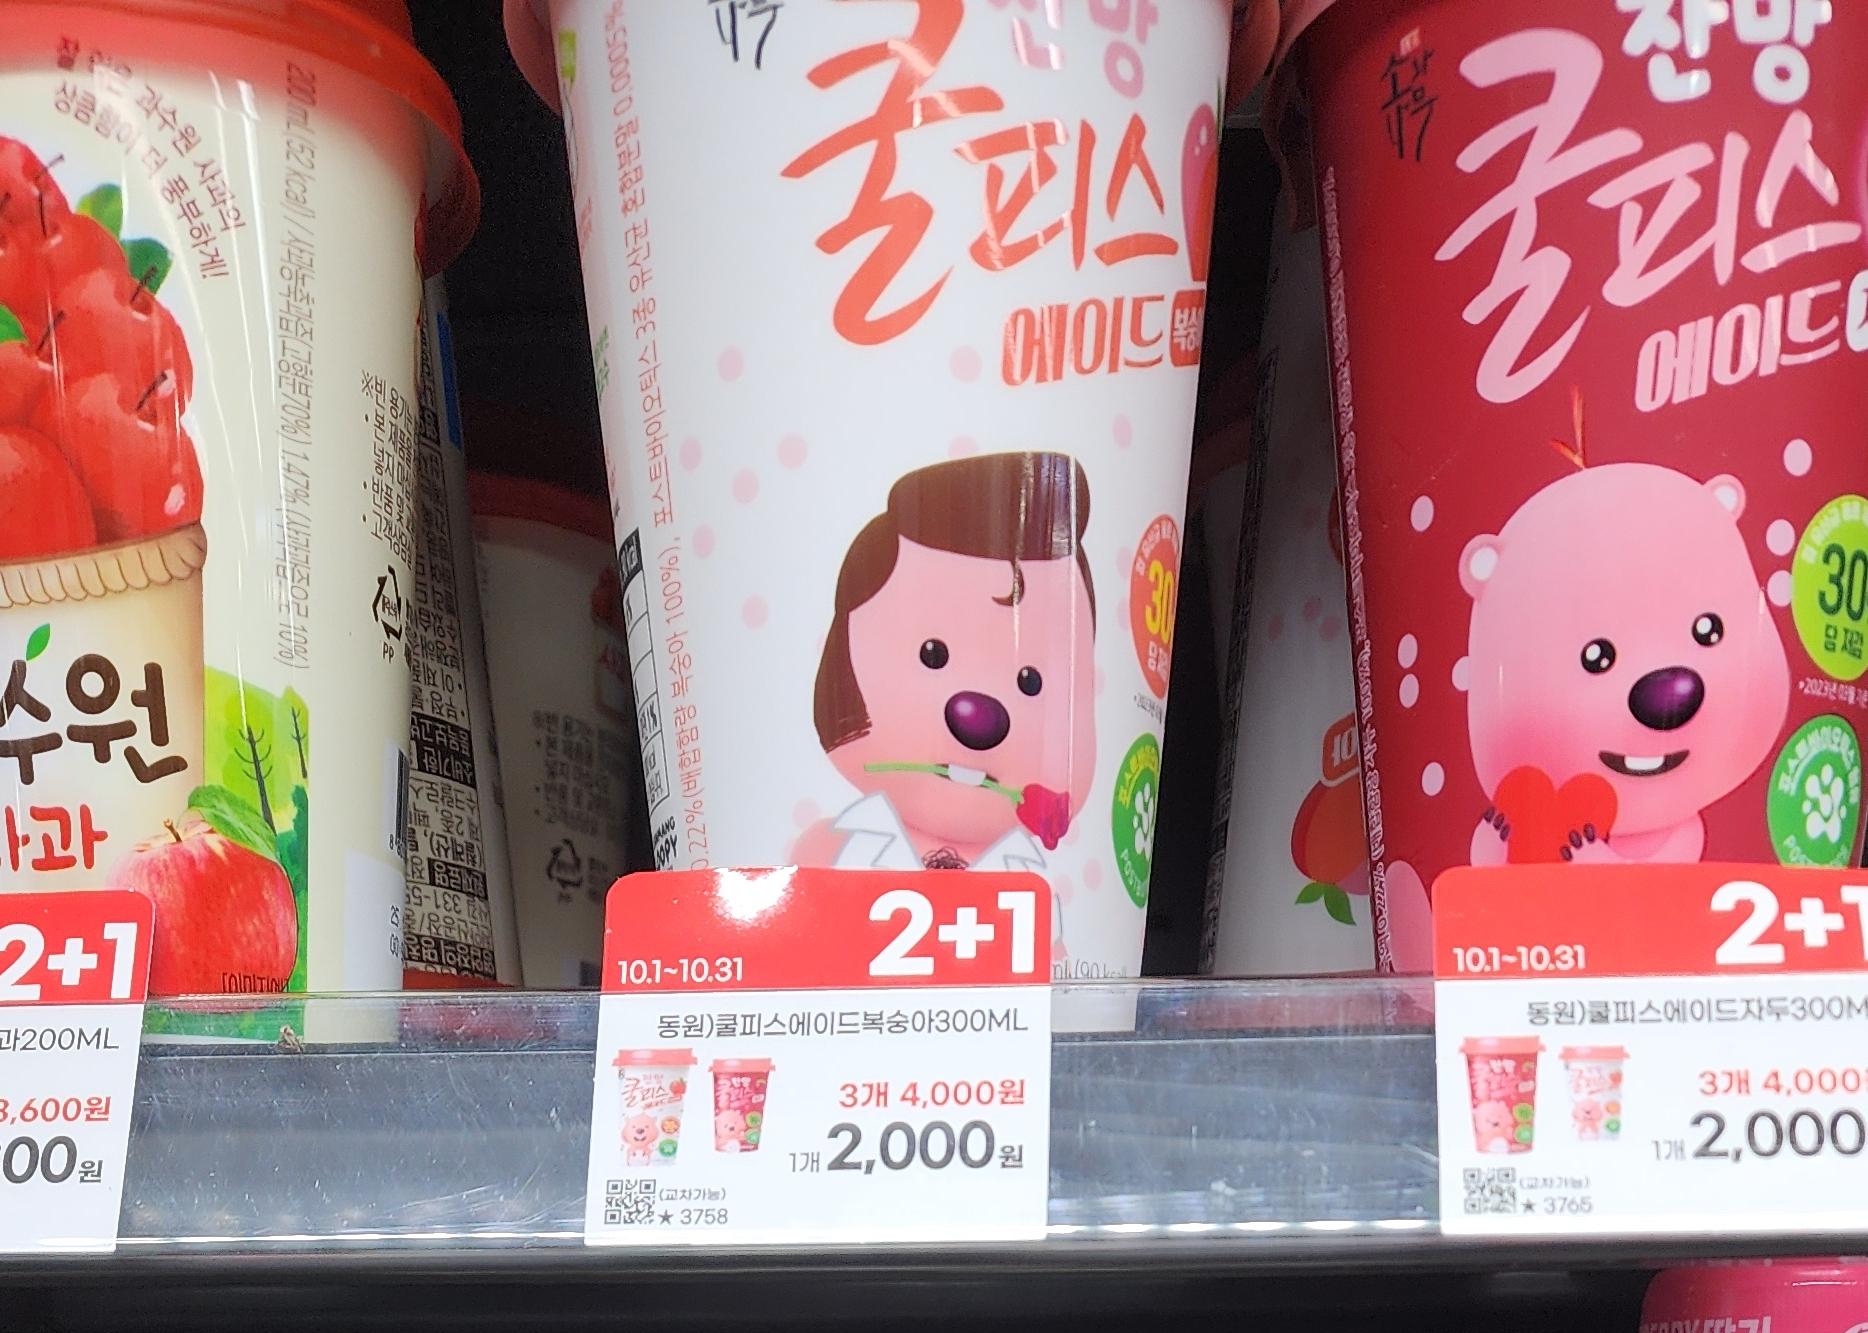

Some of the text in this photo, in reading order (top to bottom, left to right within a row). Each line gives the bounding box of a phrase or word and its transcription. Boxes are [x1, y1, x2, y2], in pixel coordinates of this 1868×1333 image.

[1434, 27, 1862, 404] 쿨피스
[1001, 294, 1166, 387] 에이드
[1634, 281, 1842, 413] 에이드
[0, 922, 138, 1000] 2+1
[617, 889, 1037, 985] 10.1~10.31 2+1
[1453, 945, 1586, 974] 10.1~10.31
[657, 1007, 1029, 1040] 동원)쿨피스에이드복숭아300ML
[839, 1078, 1027, 1110] 3개 4,000원
[1699, 1069, 1751, 1096] 3개
